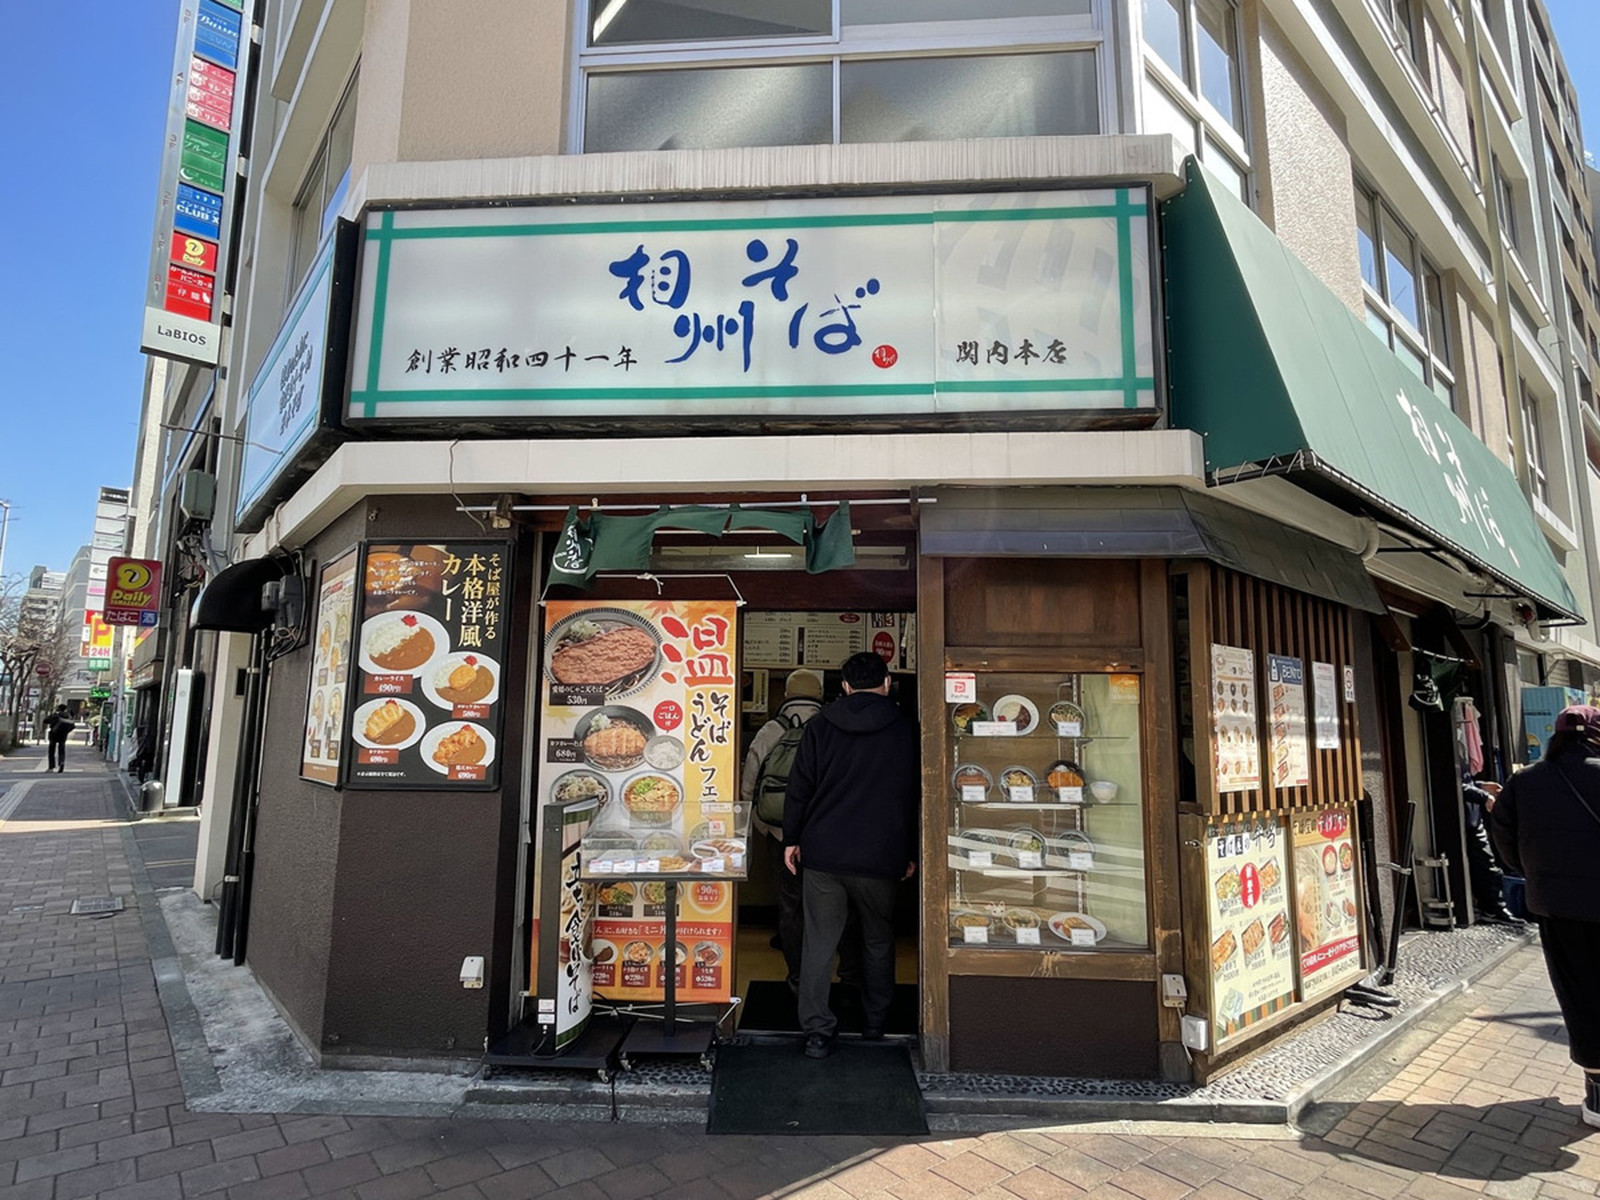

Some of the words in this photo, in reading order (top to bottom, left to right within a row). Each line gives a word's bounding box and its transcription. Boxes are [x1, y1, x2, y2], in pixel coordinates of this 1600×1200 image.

[176, 203, 209, 221] CLUB
[212, 216, 220, 225] X
[608, 238, 881, 373] 相州そば
[157, 324, 207, 346] LaBIOS
[404, 345, 638, 375] 創業昭和四十一年
[956, 338, 1068, 366] 関内本店
[111, 589, 153, 607] Daily
[440, 553, 462, 621] カレー
[458, 553, 486, 648] 本格洋風
[485, 553, 501, 640] そば屋が作る
[105, 610, 139, 622] たばこ
[142, 611, 156, 624] 酒
[91, 617, 112, 645] P
[91, 647, 110, 657] 24H
[660, 615, 734, 688] 温
[566, 695, 588, 705] 530円
[658, 712, 680, 720] ごはん
[689, 691, 711, 763] うどん
[710, 690, 732, 744] そば
